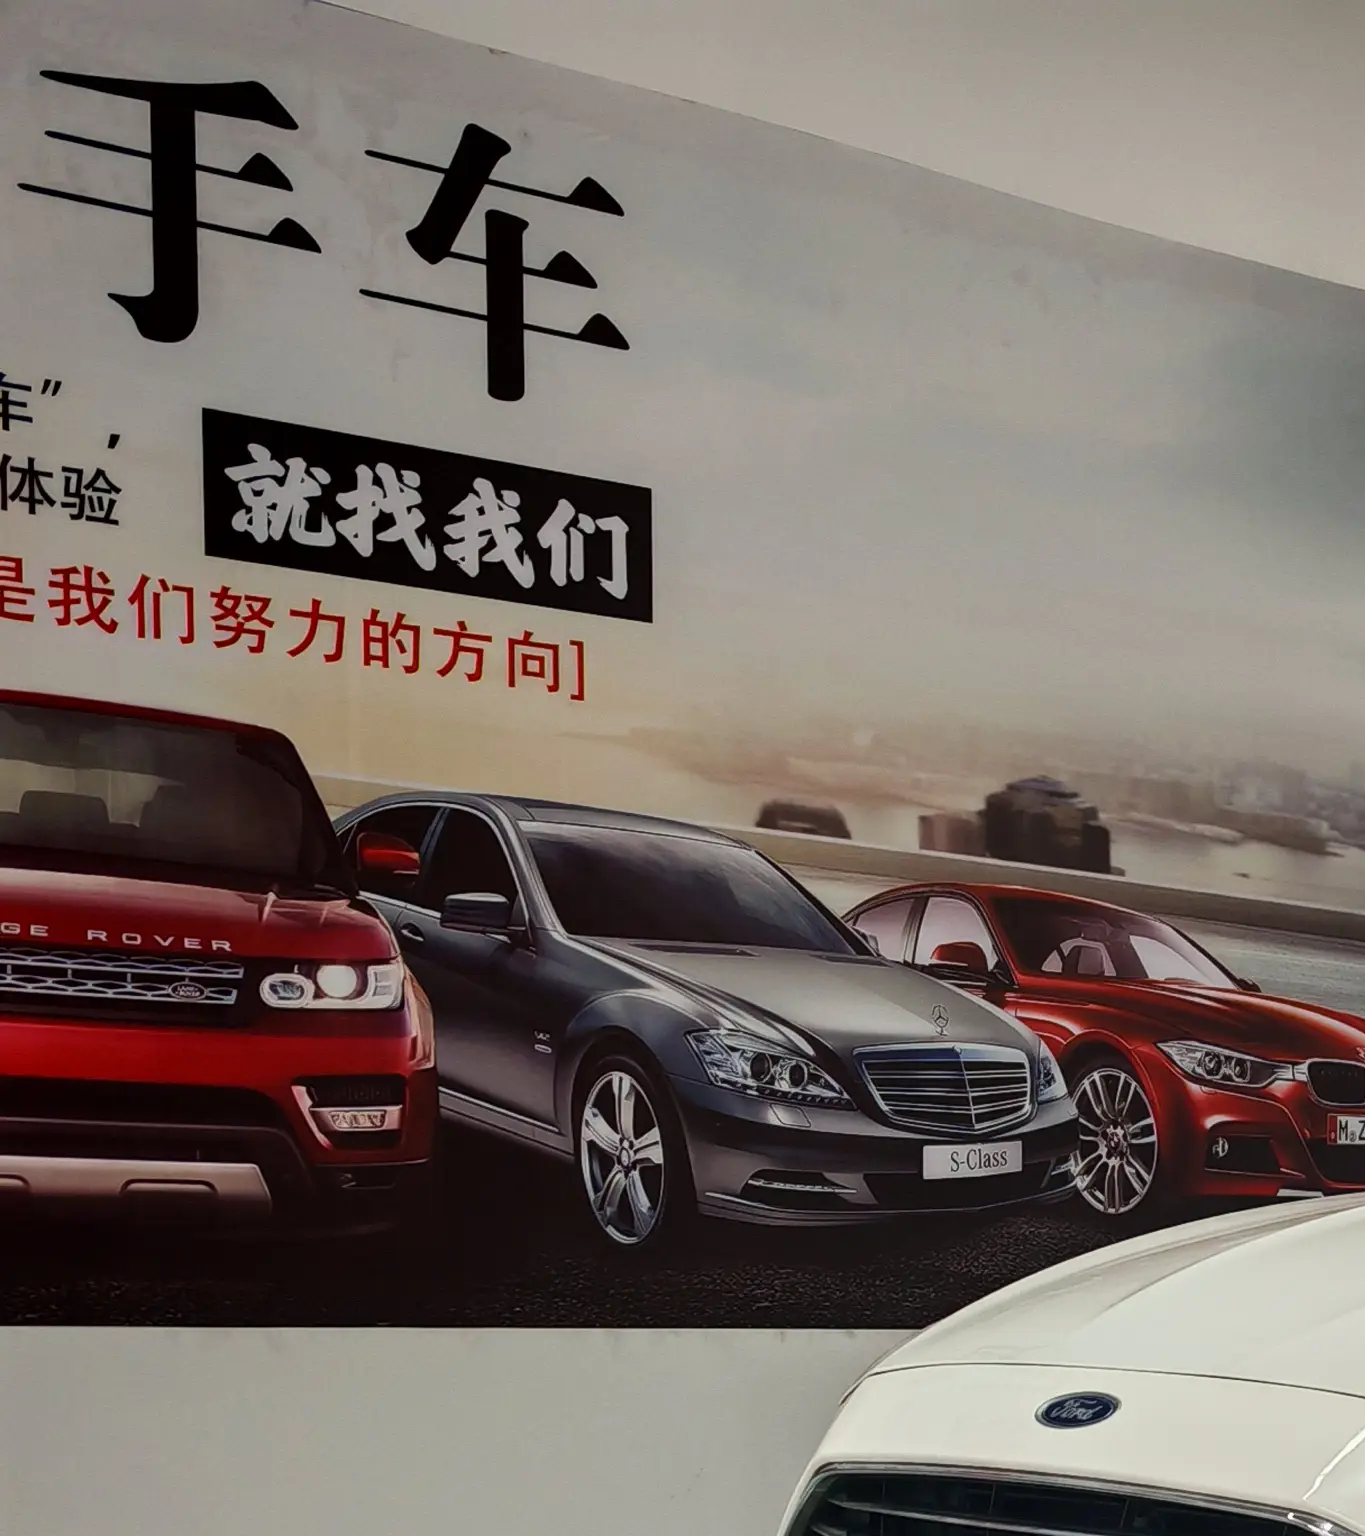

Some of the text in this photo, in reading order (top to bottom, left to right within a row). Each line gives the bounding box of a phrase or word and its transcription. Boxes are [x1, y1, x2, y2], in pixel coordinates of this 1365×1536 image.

[17, 69, 630, 402] 手车
[0, 453, 122, 526] 体验
[224, 443, 629, 600] 就找我们
[87, 929, 232, 952] ROVER
[950, 1148, 1008, 1173] S-Class
[1050, 1399, 1103, 1420] Ford
